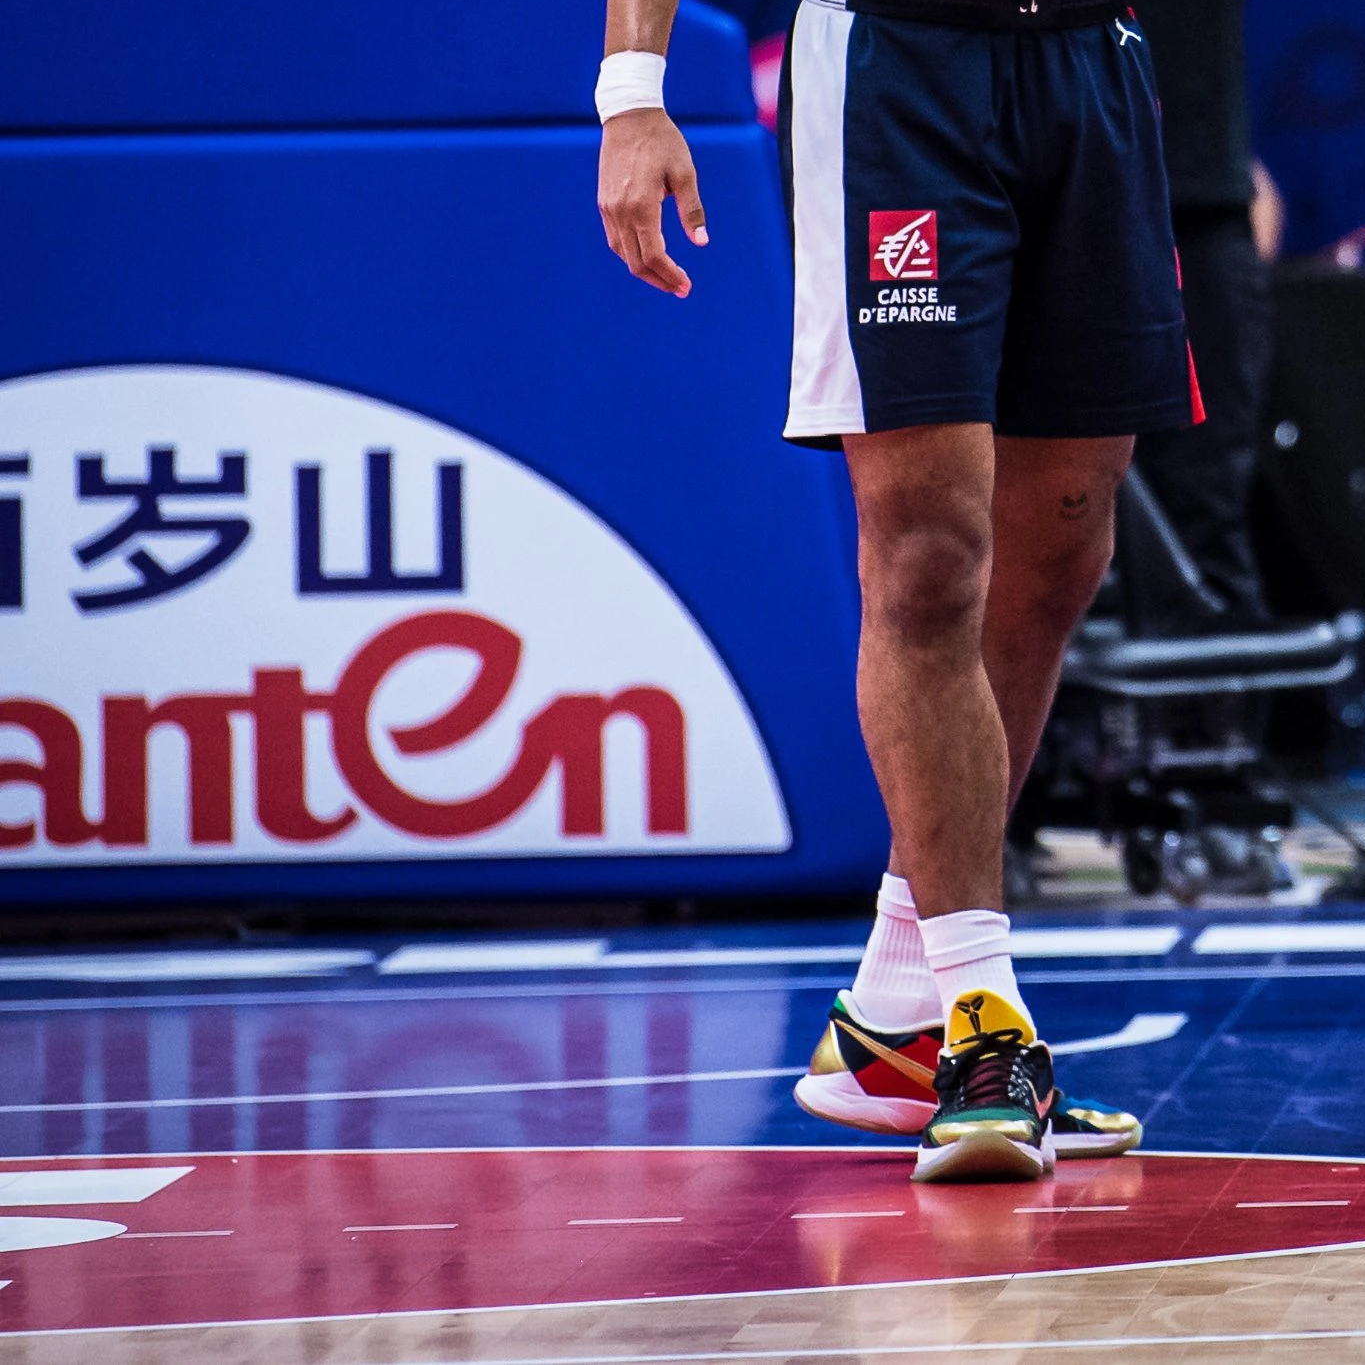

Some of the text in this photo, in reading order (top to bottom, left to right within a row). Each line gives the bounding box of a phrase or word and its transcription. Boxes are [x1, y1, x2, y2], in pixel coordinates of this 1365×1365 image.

[877, 287, 938, 305] CAISSE
[858, 305, 957, 324] D'EPARGNE
[0, 445, 464, 613] 岁山
